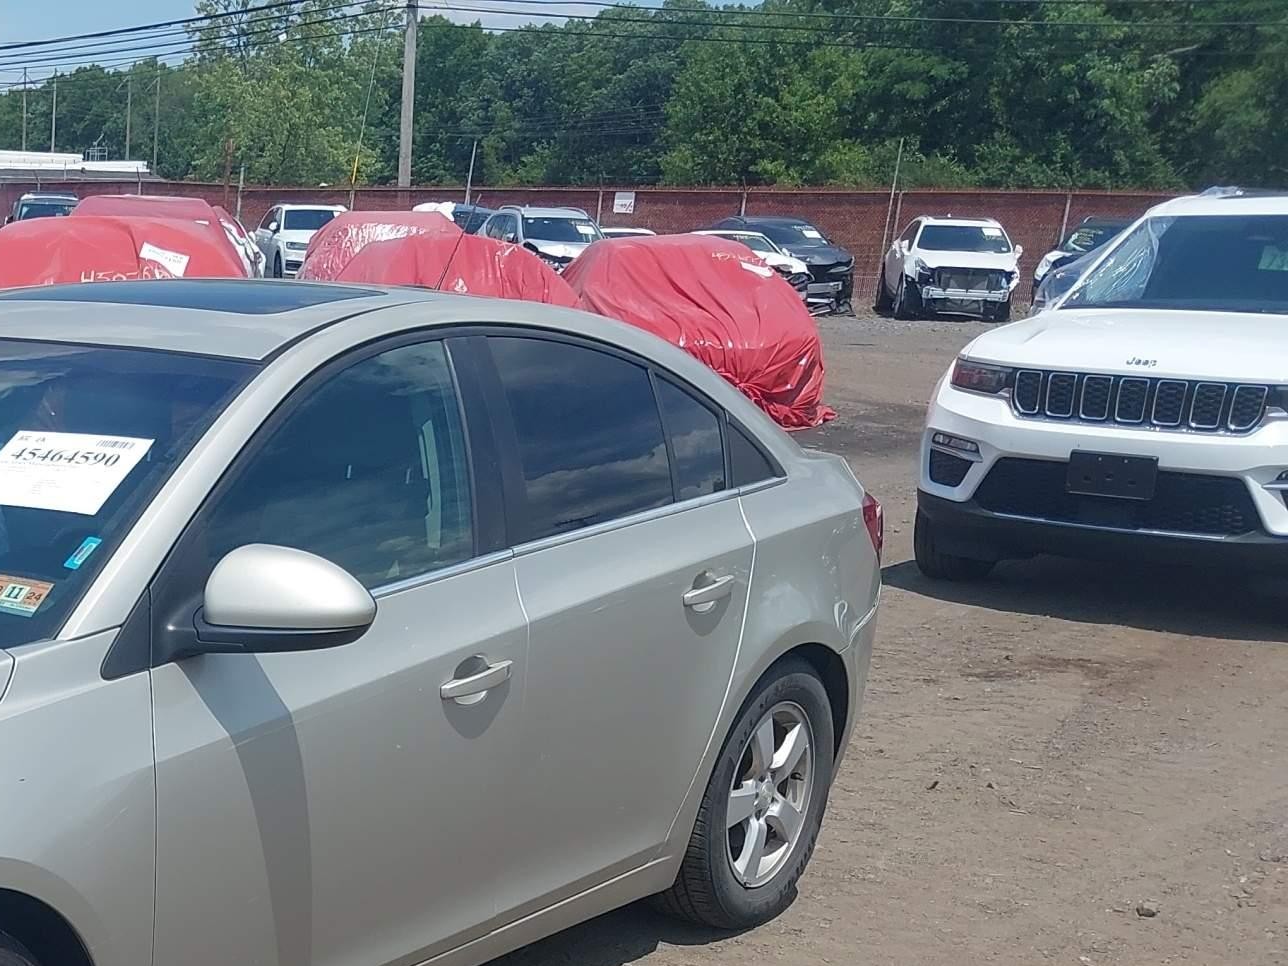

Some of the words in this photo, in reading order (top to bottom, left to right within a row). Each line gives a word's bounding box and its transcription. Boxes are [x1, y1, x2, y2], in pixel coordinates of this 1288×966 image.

[1125, 356, 1158, 369] Jeep
[10, 447, 121, 467] 45464590
[5, 585, 25, 600] 11
[26, 591, 43, 602] 24
